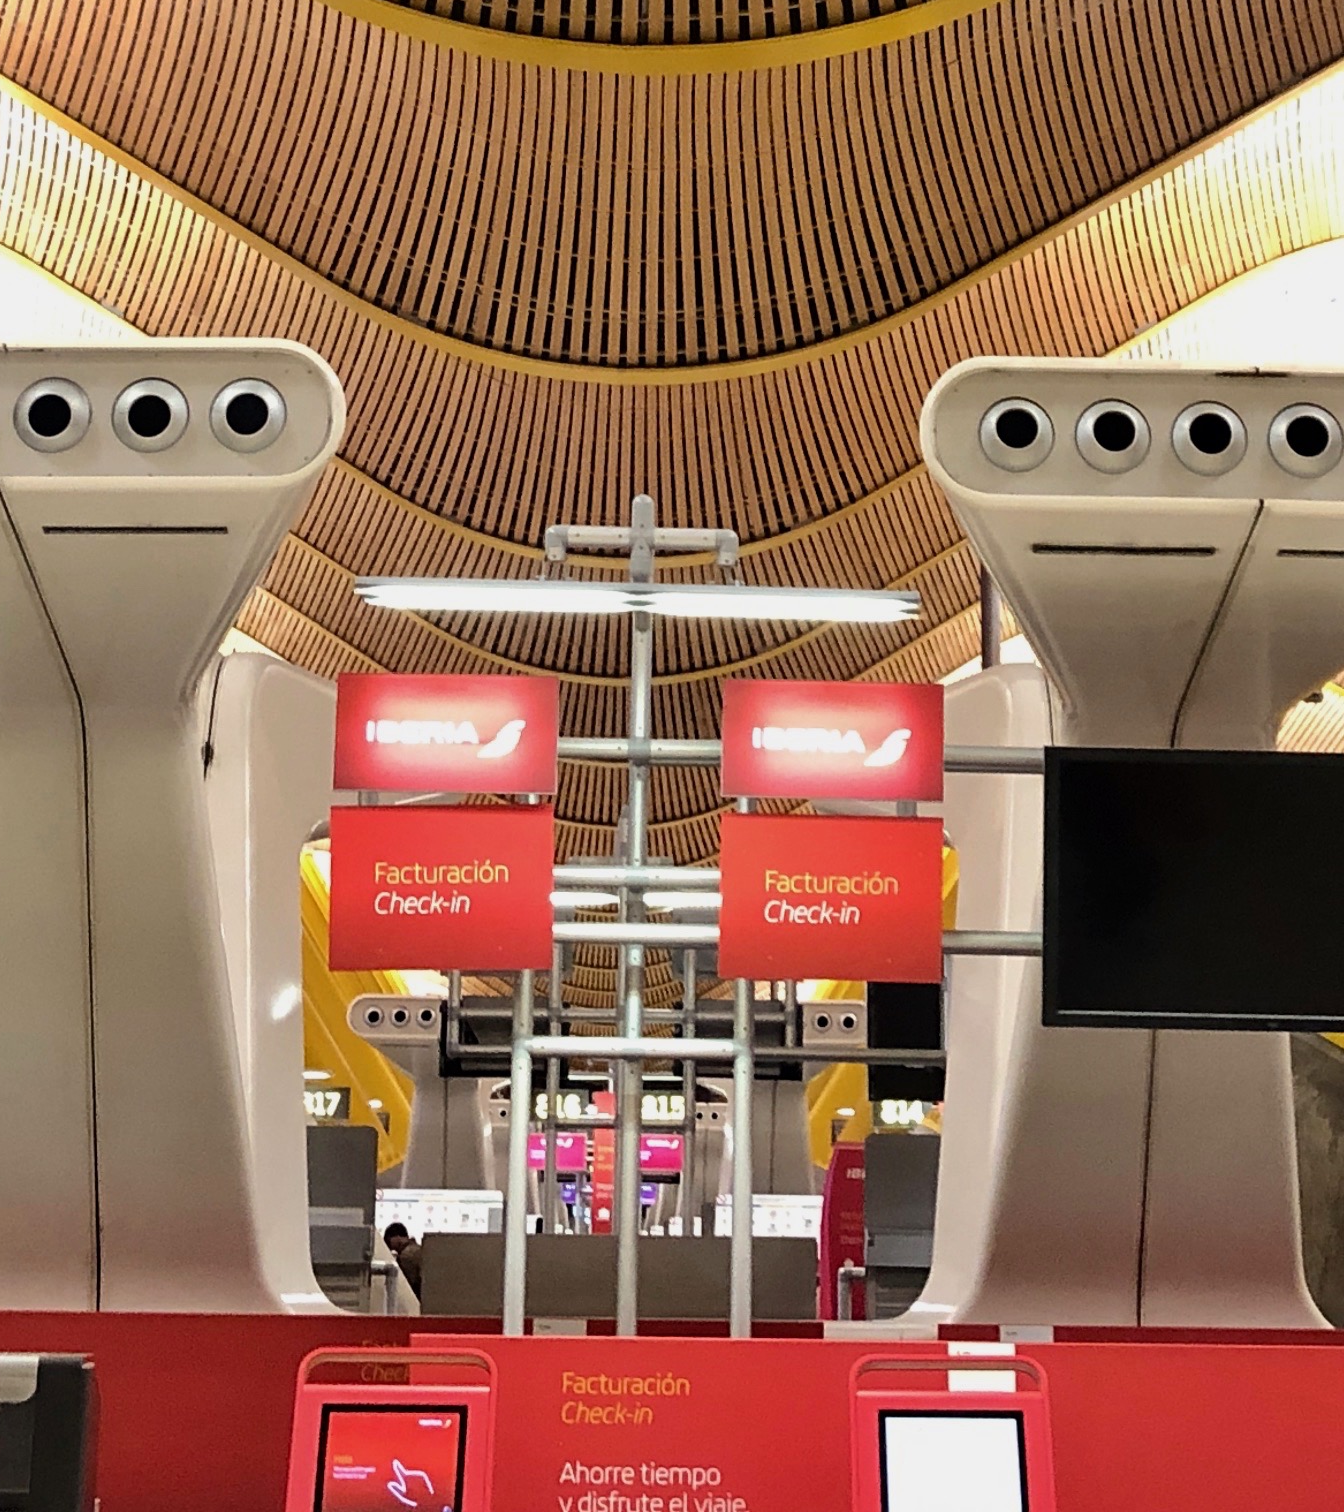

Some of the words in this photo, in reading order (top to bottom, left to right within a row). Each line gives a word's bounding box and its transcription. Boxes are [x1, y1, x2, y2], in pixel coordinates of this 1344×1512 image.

[374, 859, 510, 885] Facturación
[764, 868, 900, 896] Facturación
[374, 890, 471, 915] Check-in
[763, 899, 861, 925] Check-in
[561, 1371, 691, 1397] Facturación
[560, 1401, 654, 1425] Check-in
[558, 1459, 636, 1486] Ahorre
[639, 1461, 722, 1491] tiempo
[577, 1490, 664, 1512] disfrute
[668, 1491, 688, 1512] el
